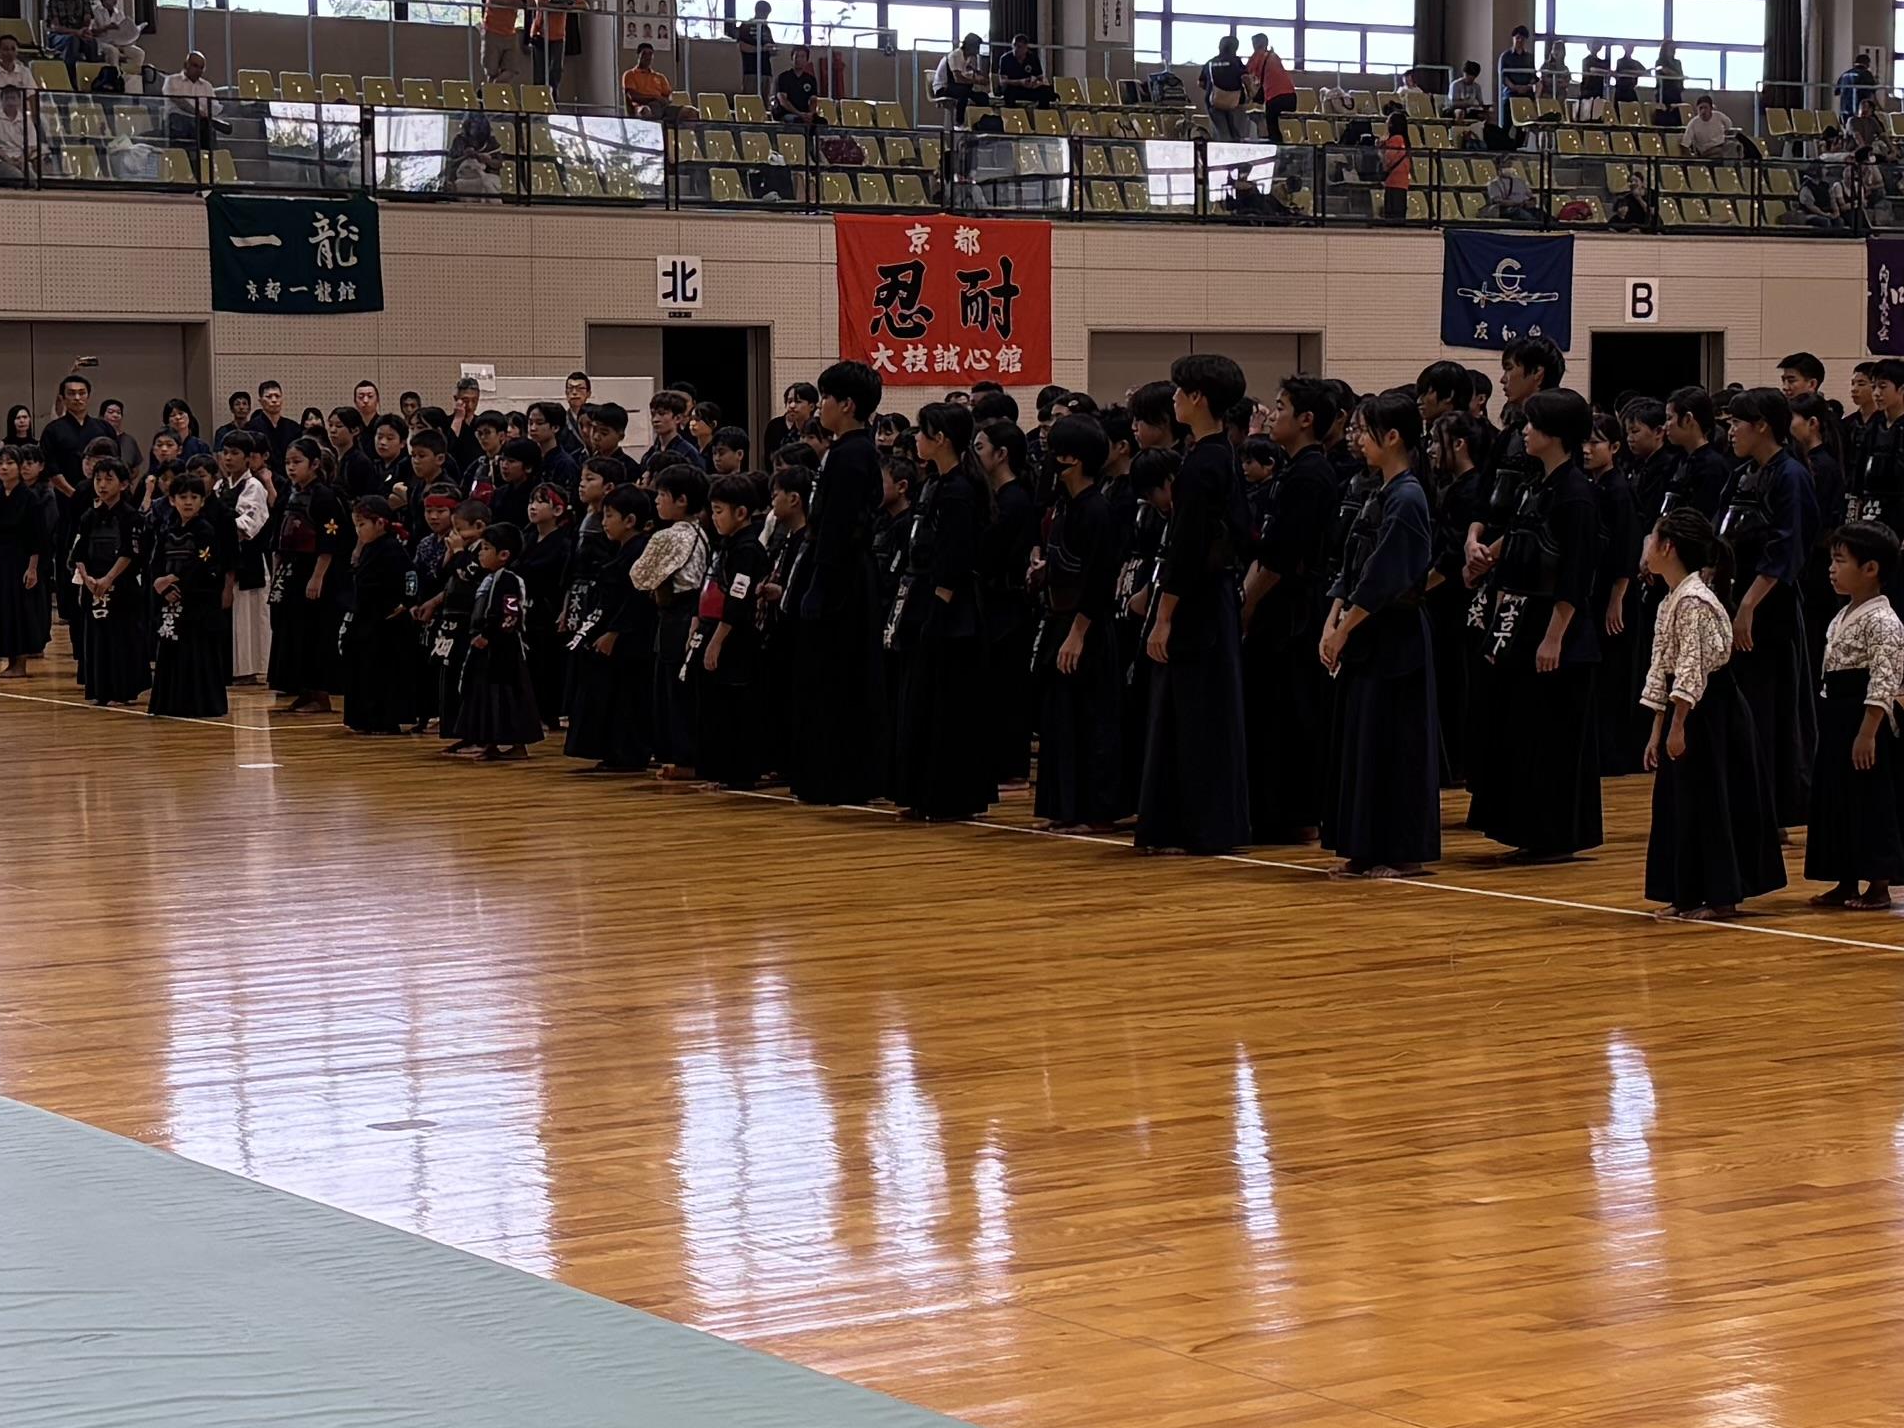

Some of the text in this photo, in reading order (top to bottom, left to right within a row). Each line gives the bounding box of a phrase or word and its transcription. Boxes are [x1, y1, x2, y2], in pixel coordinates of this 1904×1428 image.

[229, 211, 359, 269] 一龍
[905, 223, 980, 256] 京都
[246, 278, 357, 303] 京都一龍館
[662, 260, 698, 303] 北
[869, 255, 1021, 341] 忍耐
[1631, 282, 1653, 319] B
[870, 342, 1023, 374] 大枝誠心館
